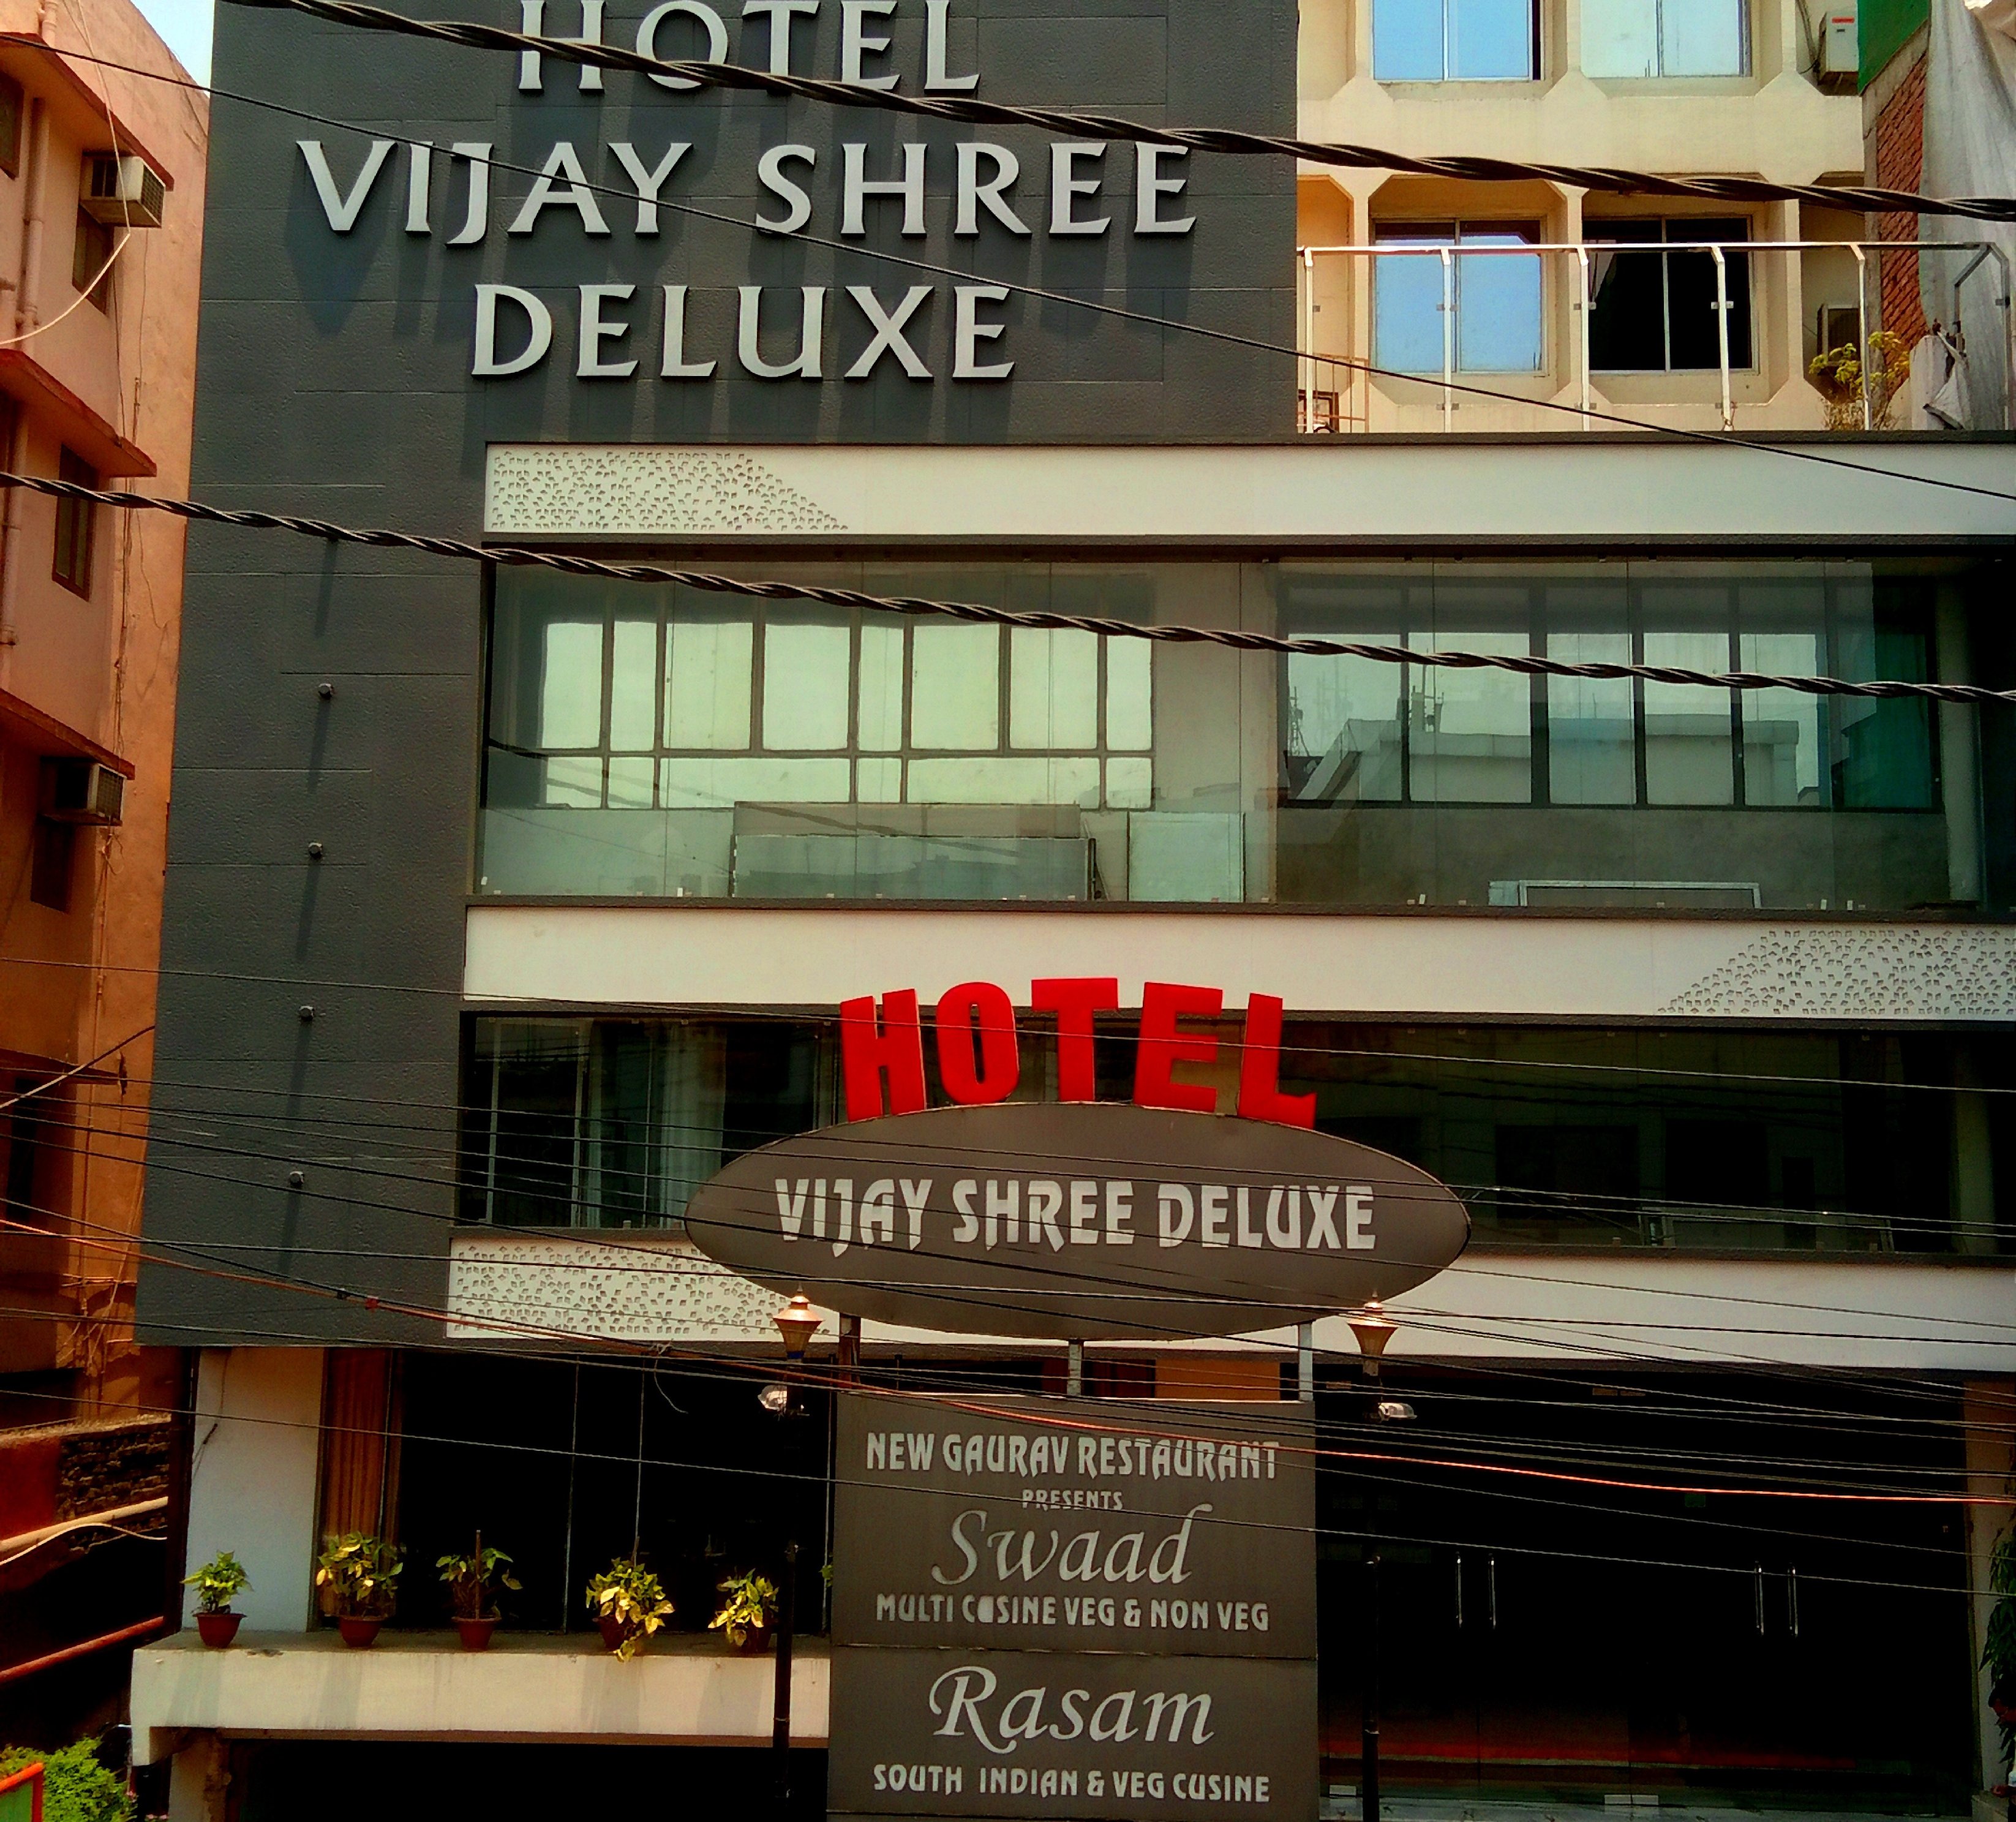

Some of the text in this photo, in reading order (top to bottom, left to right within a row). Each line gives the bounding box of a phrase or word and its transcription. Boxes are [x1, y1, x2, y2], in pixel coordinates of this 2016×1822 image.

[517, 0, 980, 91] HOTEL
[296, 140, 1197, 244] VIJAY SHREE
[472, 284, 1015, 378] DELUXE
[841, 978, 1315, 1127] HOTEL
[775, 1179, 1375, 1257] VIJAY SHREE DELUXE
[867, 1433, 1279, 1481] NEW GAURAV RESTAURANT
[1022, 1489, 1123, 1511] PRESENTS
[931, 1503, 1213, 1584] Swaad
[877, 1594, 953, 1622] MULTI
[1064, 1598, 1114, 1626] VEG
[1124, 1599, 1141, 1627] &
[1151, 1600, 1208, 1628] NON
[1217, 1602, 1268, 1630] VEG
[930, 1666, 1214, 1753] Rasam
[874, 1764, 1269, 1802] SOUTH INDIAN & VEG CUSINE
